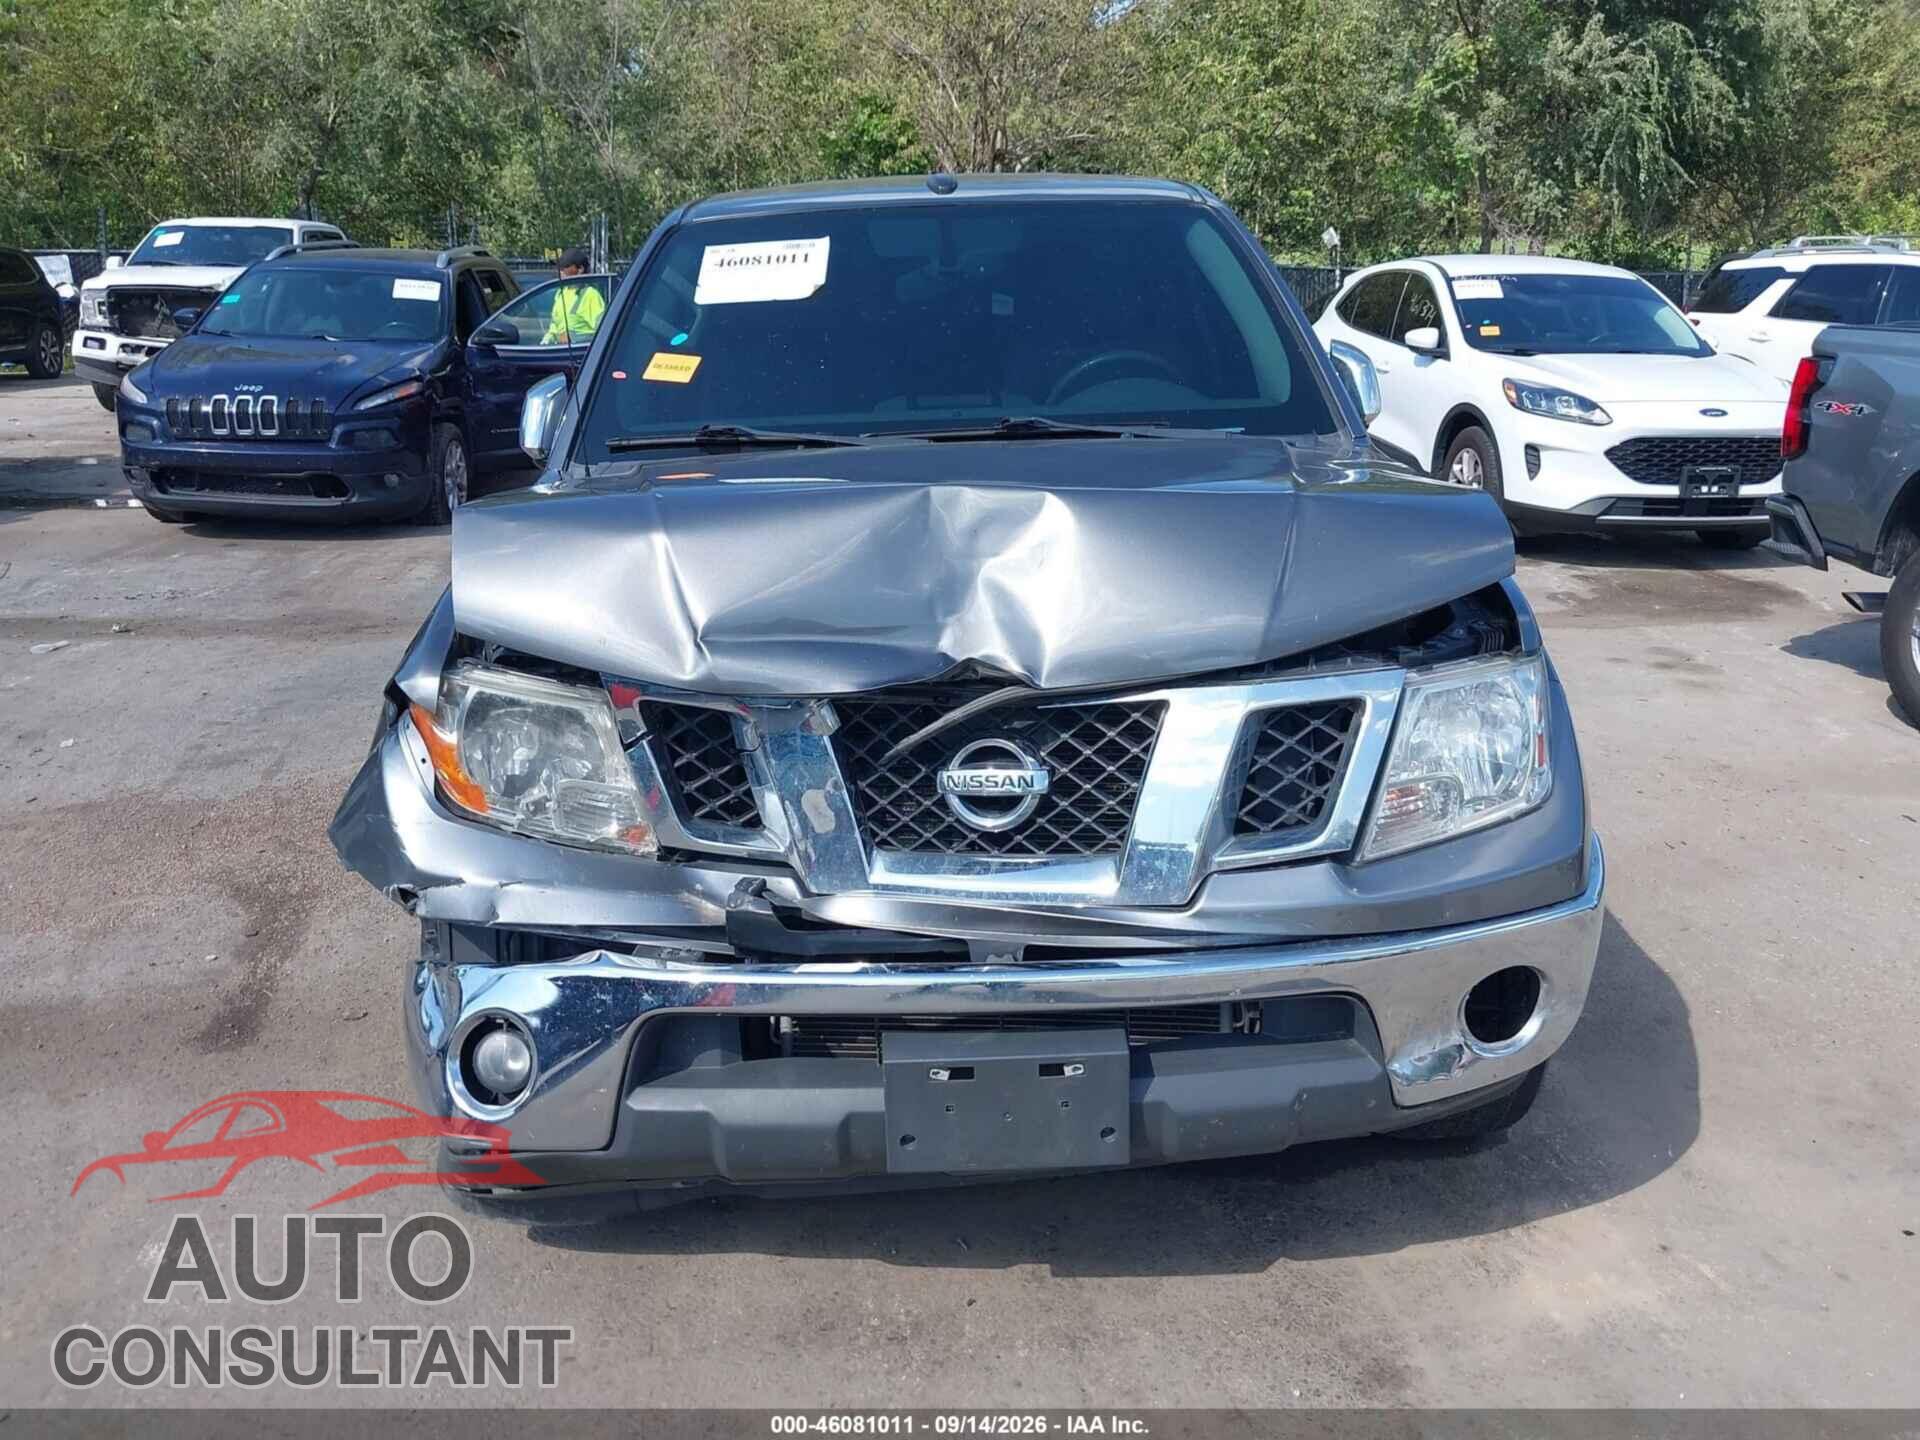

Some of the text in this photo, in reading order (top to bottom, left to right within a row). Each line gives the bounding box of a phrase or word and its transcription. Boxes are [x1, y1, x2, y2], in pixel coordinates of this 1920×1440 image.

[714, 253, 809, 268] 46081011
[233, 383, 264, 393] Jeep
[946, 775, 1034, 789] NISSAN
